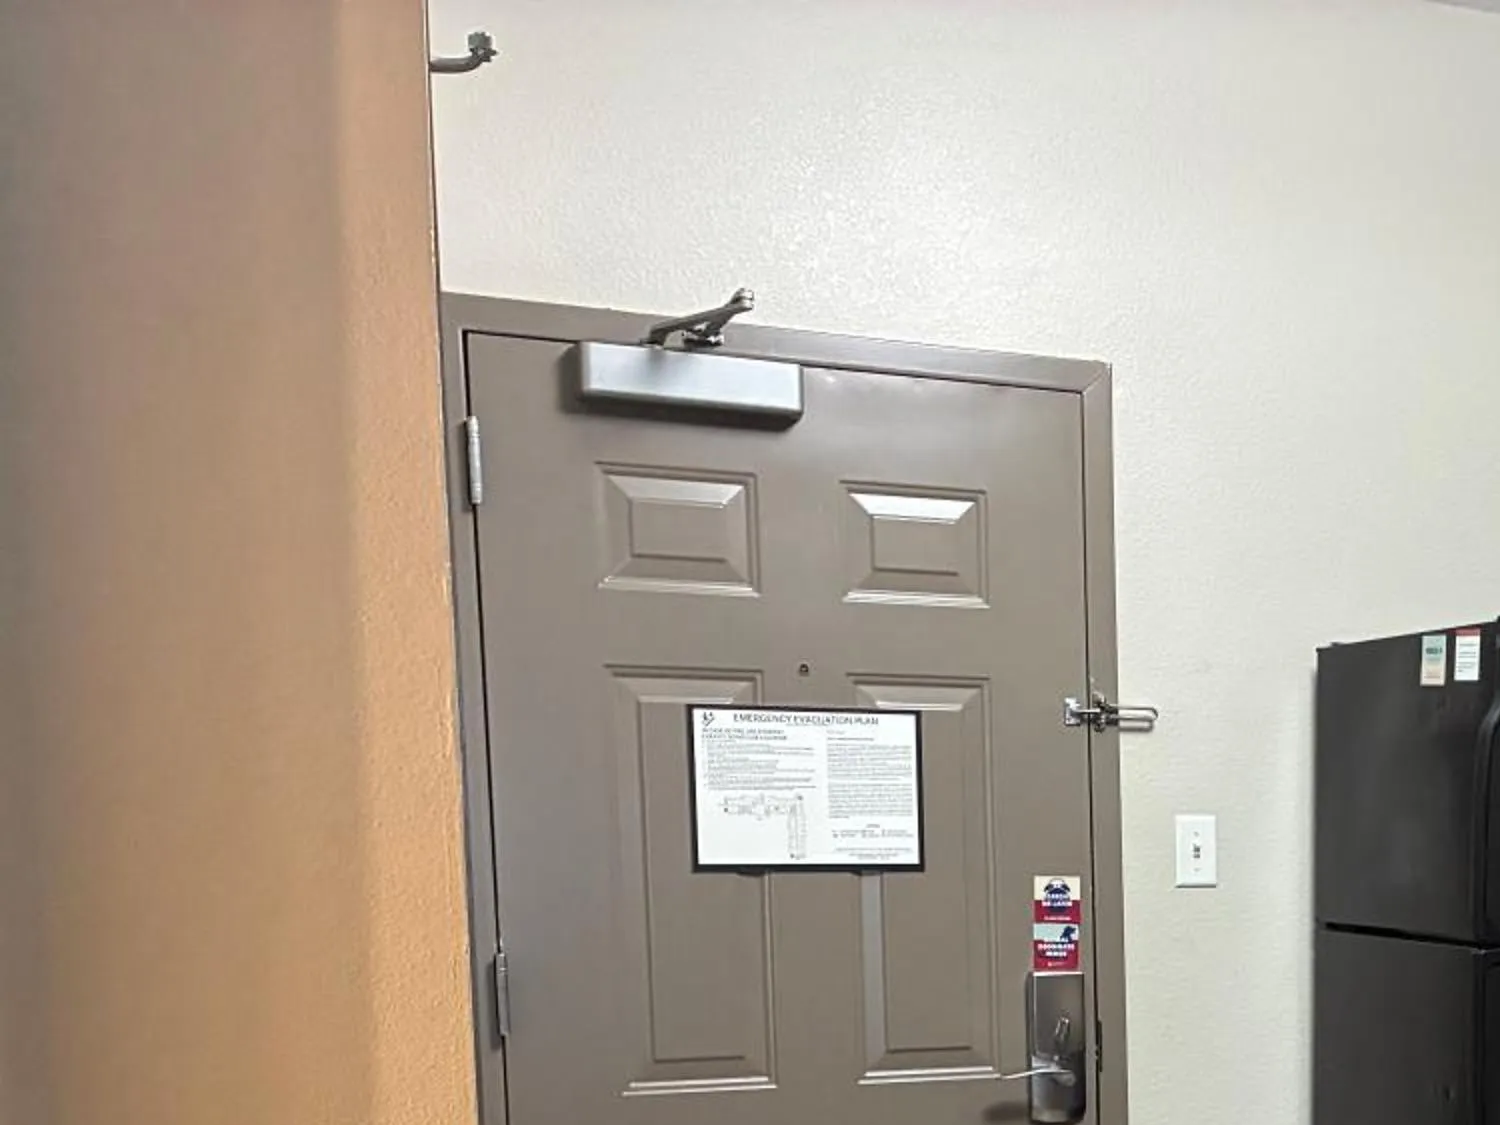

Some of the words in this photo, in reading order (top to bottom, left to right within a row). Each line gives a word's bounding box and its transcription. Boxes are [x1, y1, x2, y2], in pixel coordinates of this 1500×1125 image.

[733, 713, 791, 724] EMERGENCY
[793, 714, 852, 726] EVACUATION
[853, 715, 879, 725] PLAN
